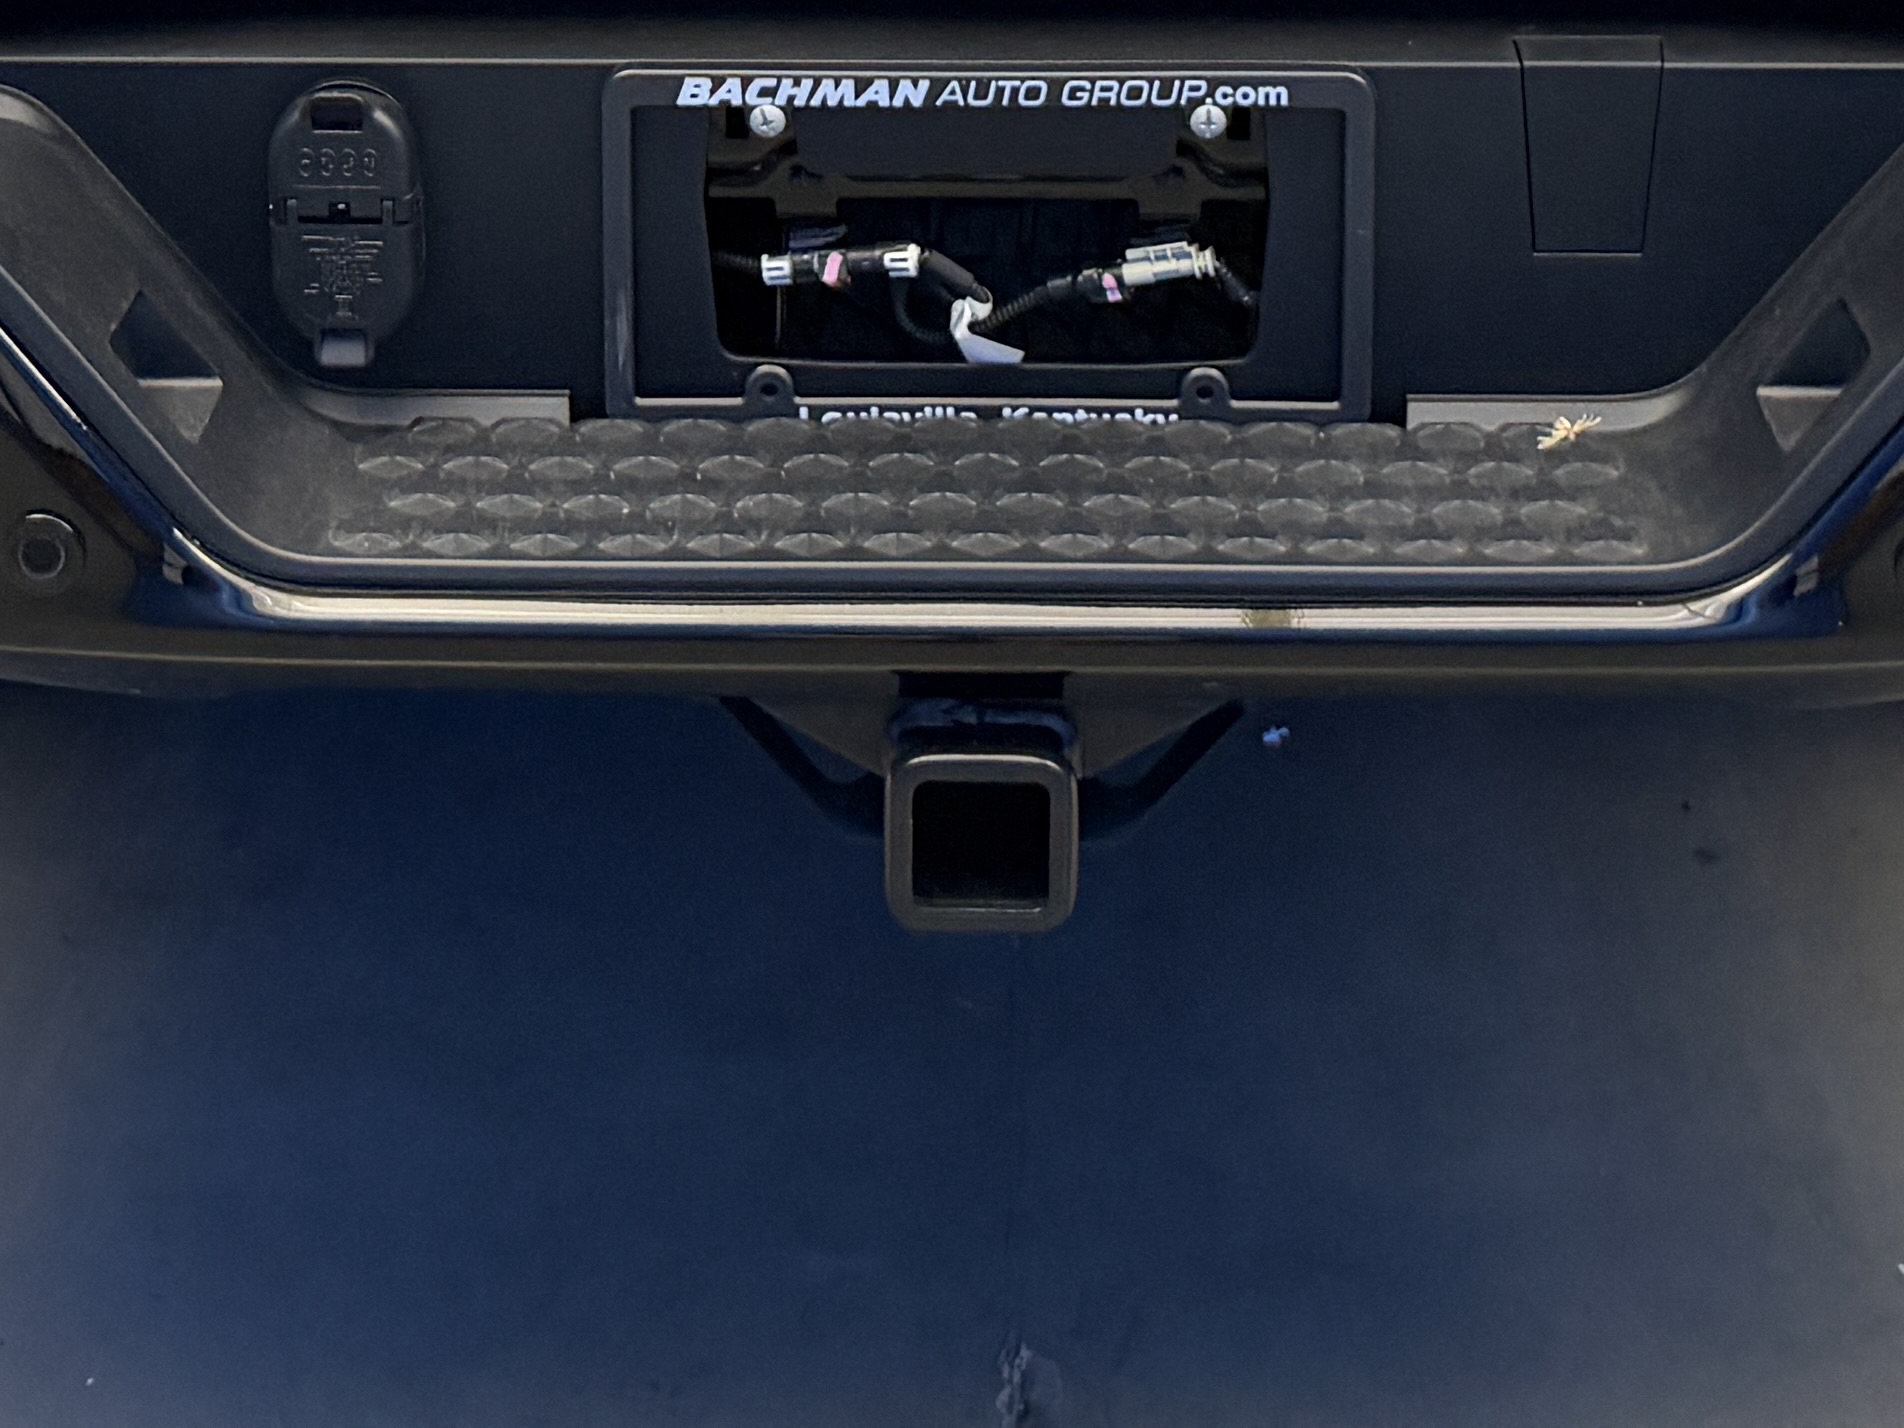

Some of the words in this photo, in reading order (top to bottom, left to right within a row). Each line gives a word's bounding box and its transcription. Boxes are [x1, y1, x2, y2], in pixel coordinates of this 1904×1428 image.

[676, 76, 930, 107] BACHMAN
[935, 79, 1048, 107] AUTO
[1060, 79, 1289, 108] GROUP.com
